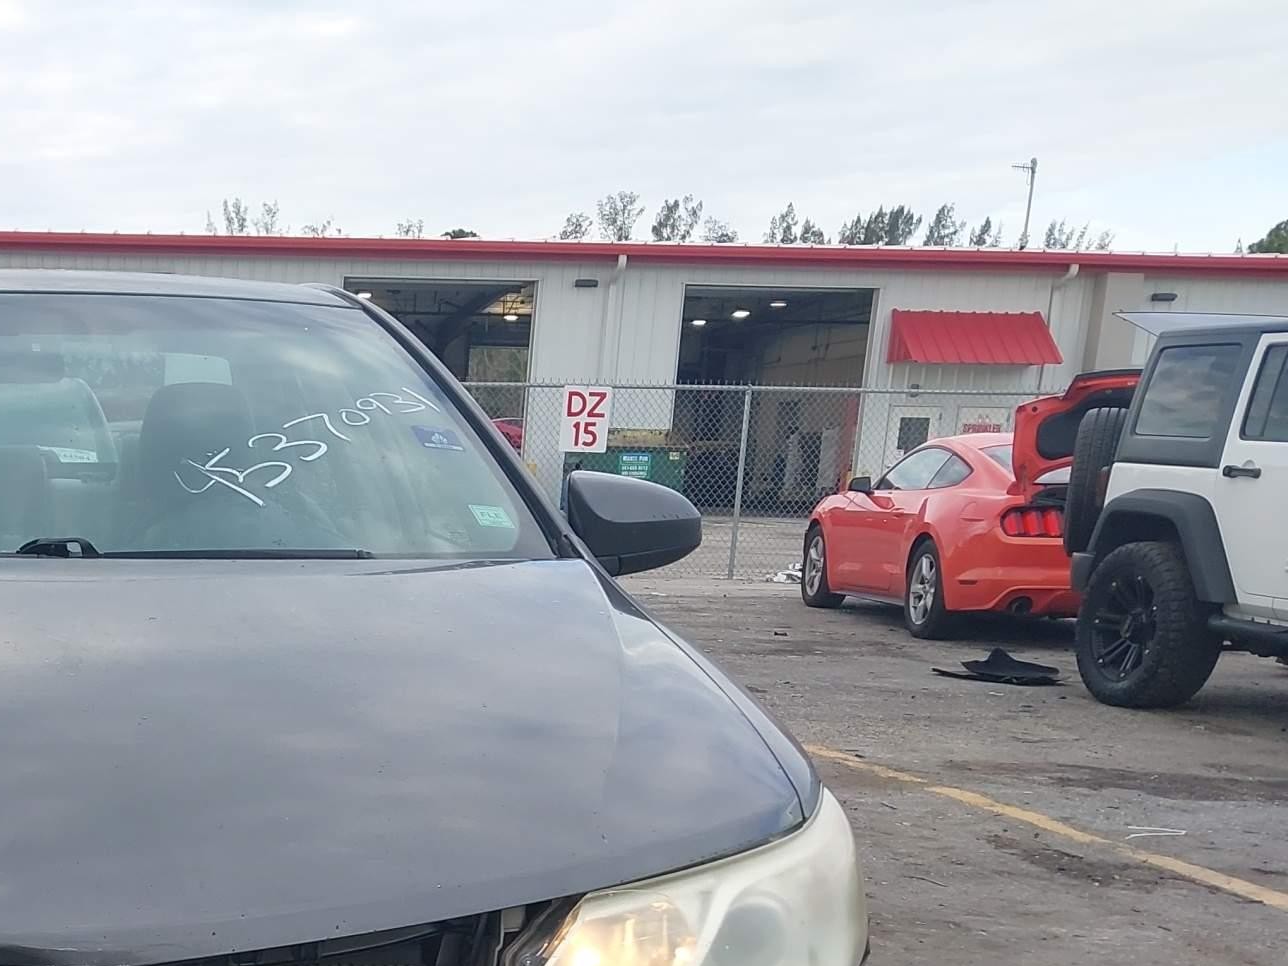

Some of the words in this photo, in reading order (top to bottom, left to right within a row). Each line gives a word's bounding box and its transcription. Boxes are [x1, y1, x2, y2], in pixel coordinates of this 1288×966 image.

[567, 391, 607, 418] DZ
[174, 387, 440, 506] 45370931
[572, 421, 598, 447] 15
